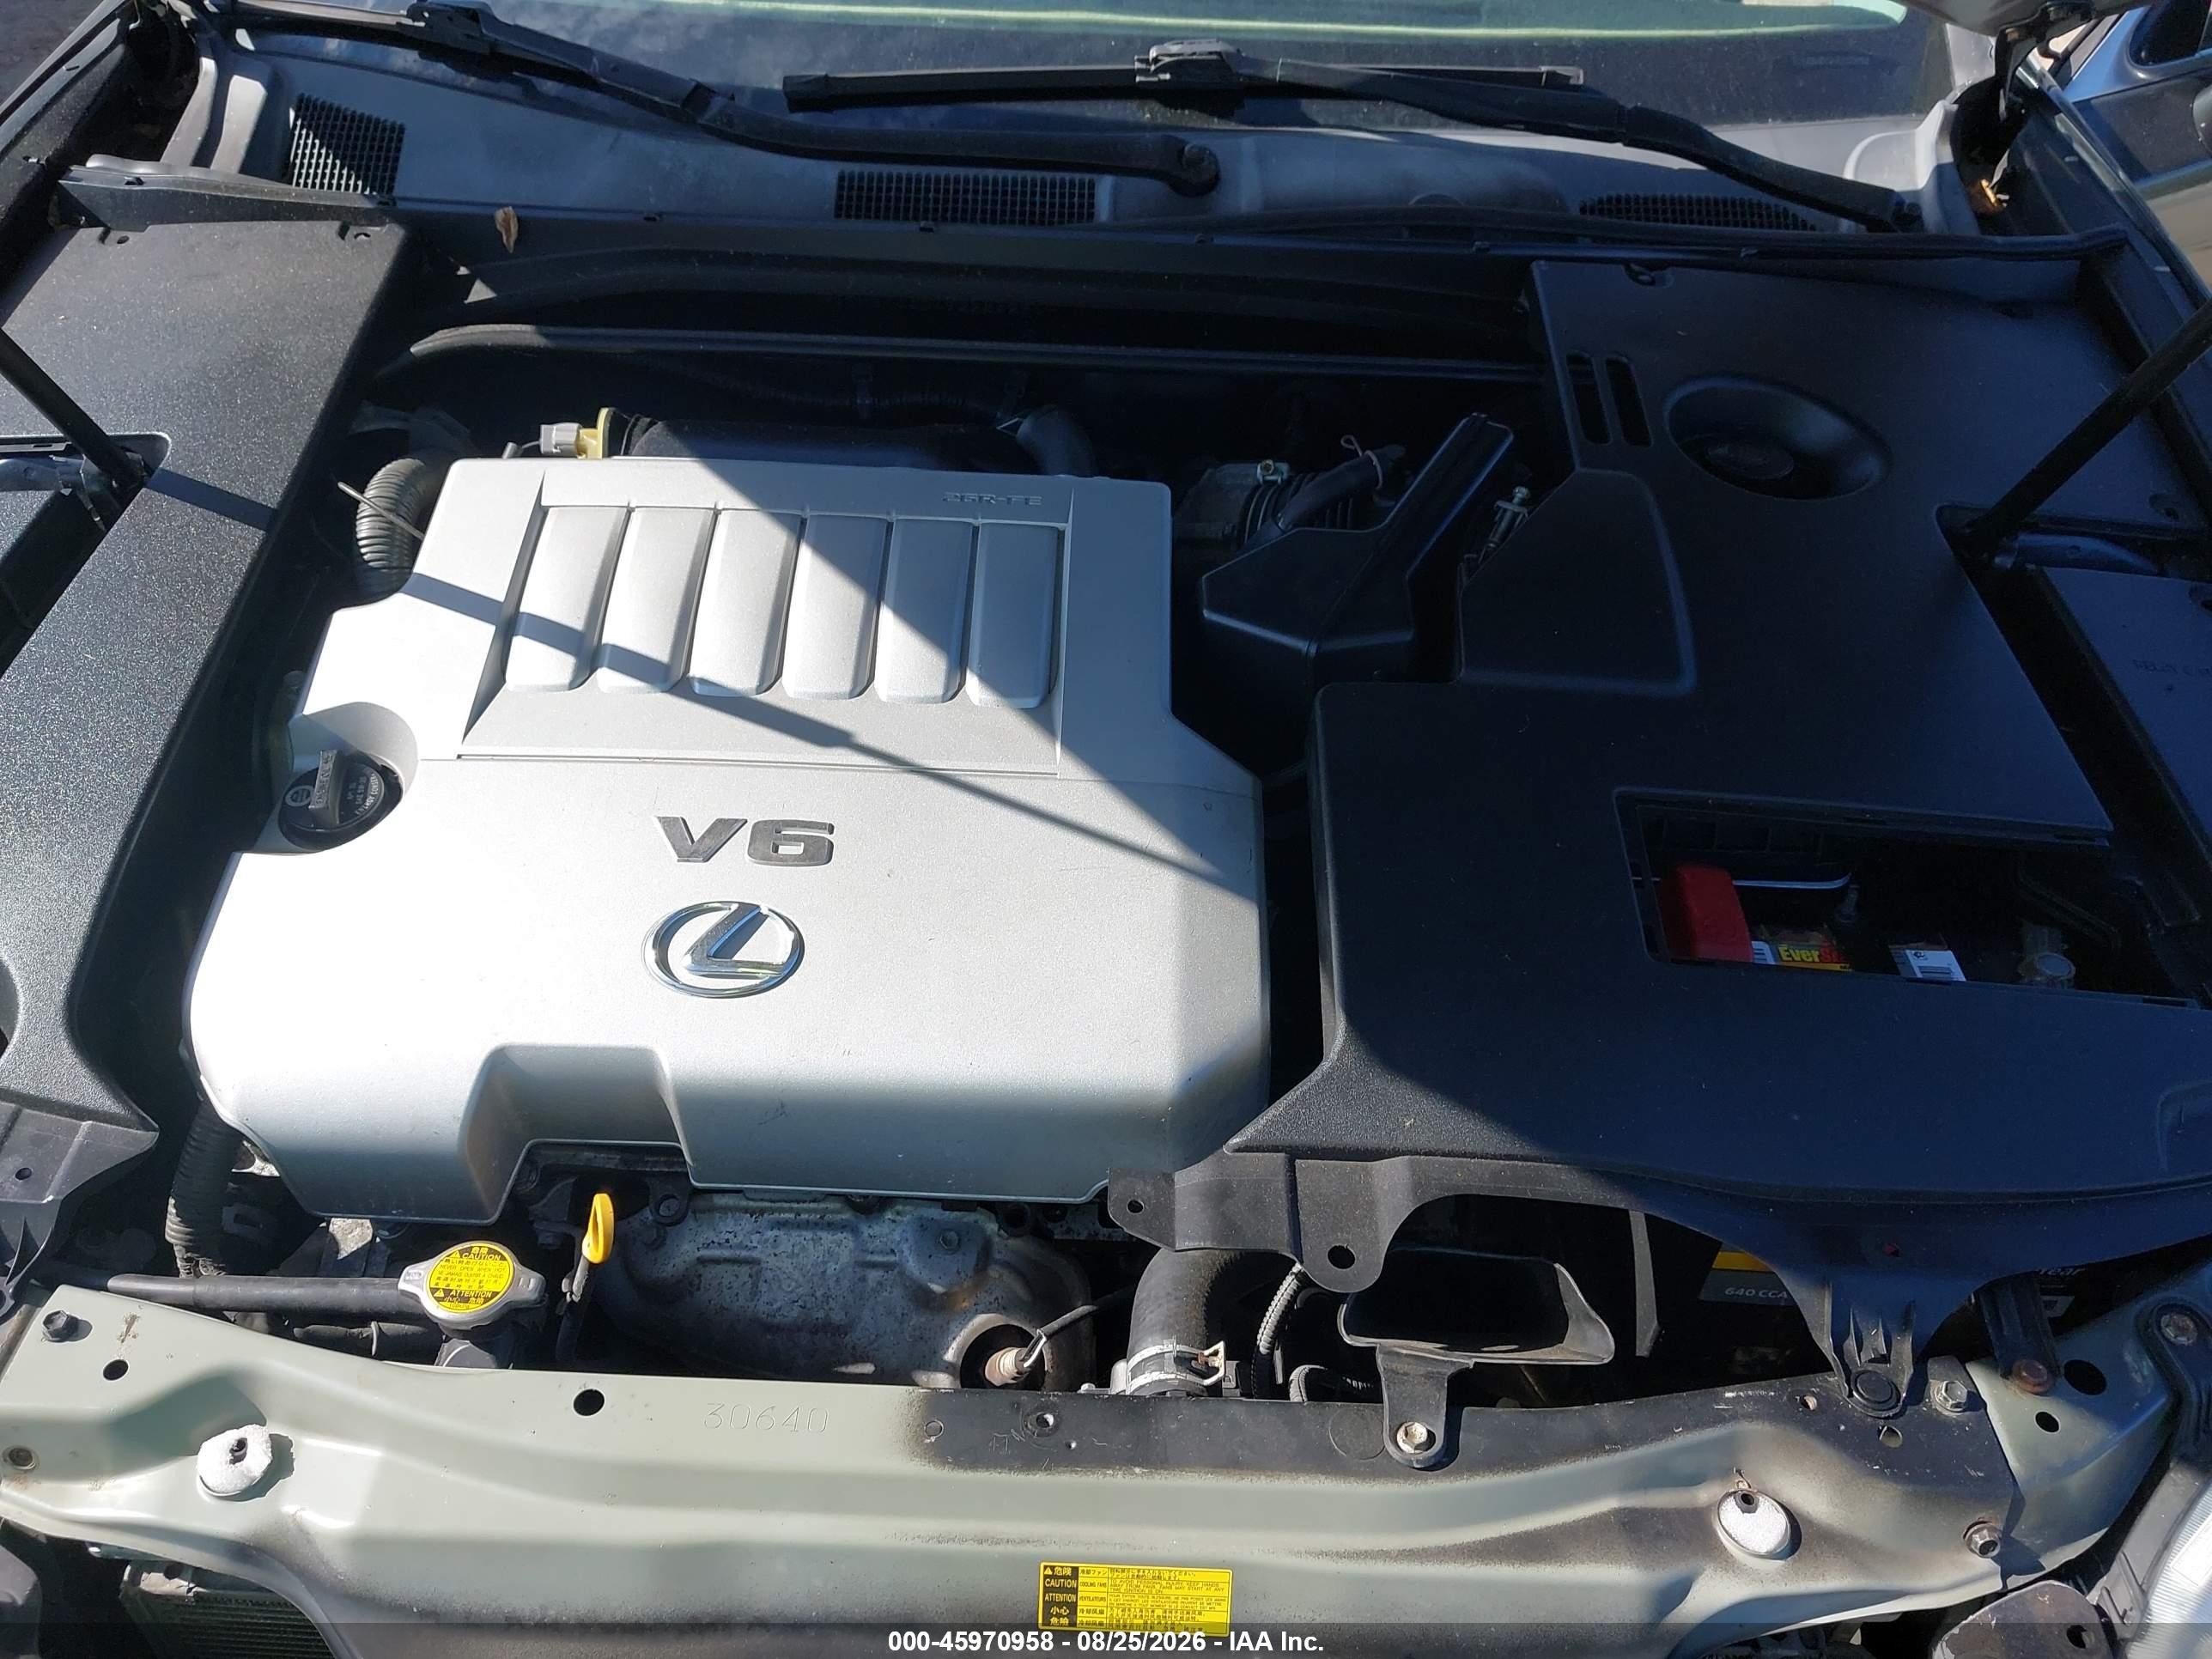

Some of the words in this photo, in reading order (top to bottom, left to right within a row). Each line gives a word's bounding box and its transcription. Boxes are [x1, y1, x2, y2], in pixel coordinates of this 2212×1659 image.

[654, 816, 835, 866] V6
[450, 1290, 493, 1298] ATTENTION
[1724, 1286, 1755, 1297] 640
[1758, 1289, 1788, 1299] CCA
[704, 1402, 829, 1433] 30640
[1044, 1578, 1078, 1589] CAUTION
[1044, 1593, 1077, 1602] ATTENTION
[1050, 1606, 1070, 1615] 小心
